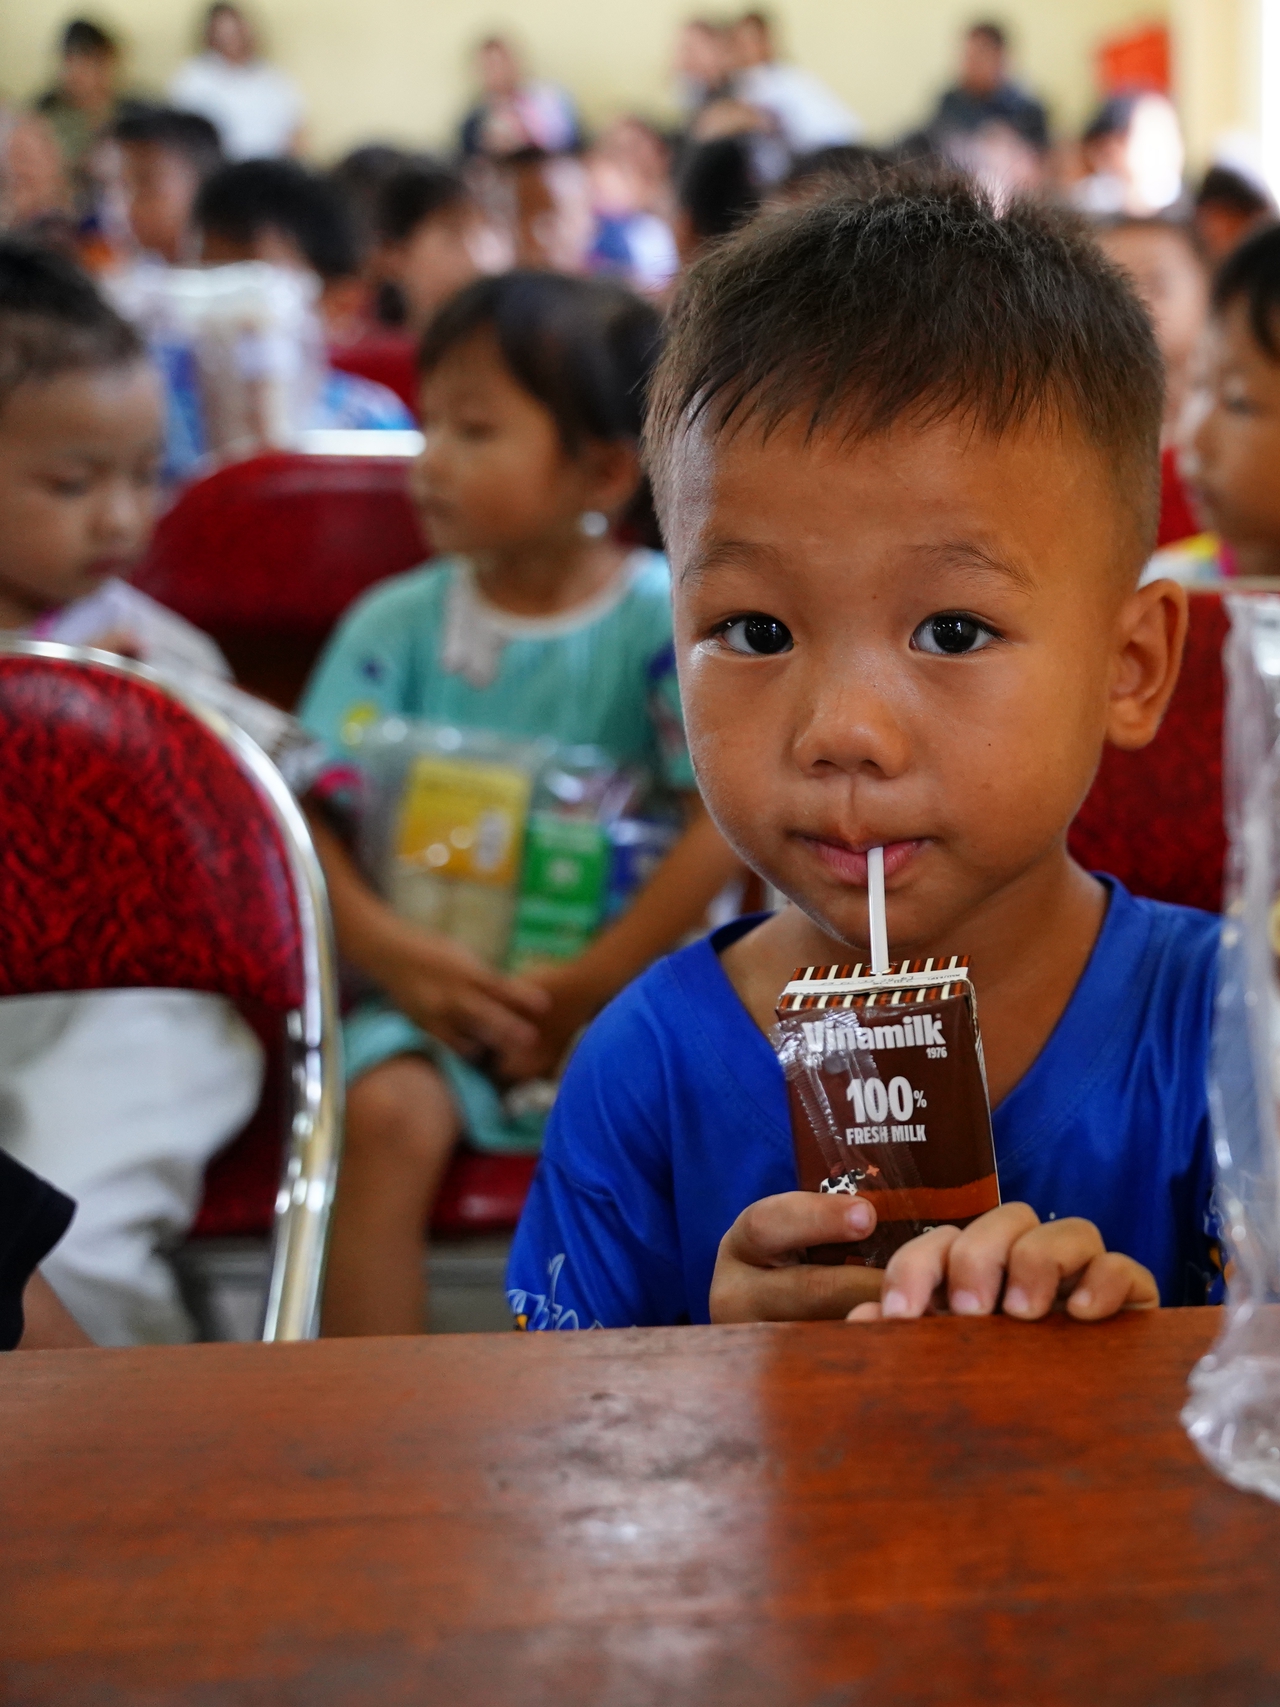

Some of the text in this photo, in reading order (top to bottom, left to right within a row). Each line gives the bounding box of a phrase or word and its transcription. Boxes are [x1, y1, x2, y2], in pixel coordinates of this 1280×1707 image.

[802, 1013, 946, 1052] Vinamilk
[926, 1047, 948, 1060] 1976
[846, 1125, 927, 1145] FRESH MILK
